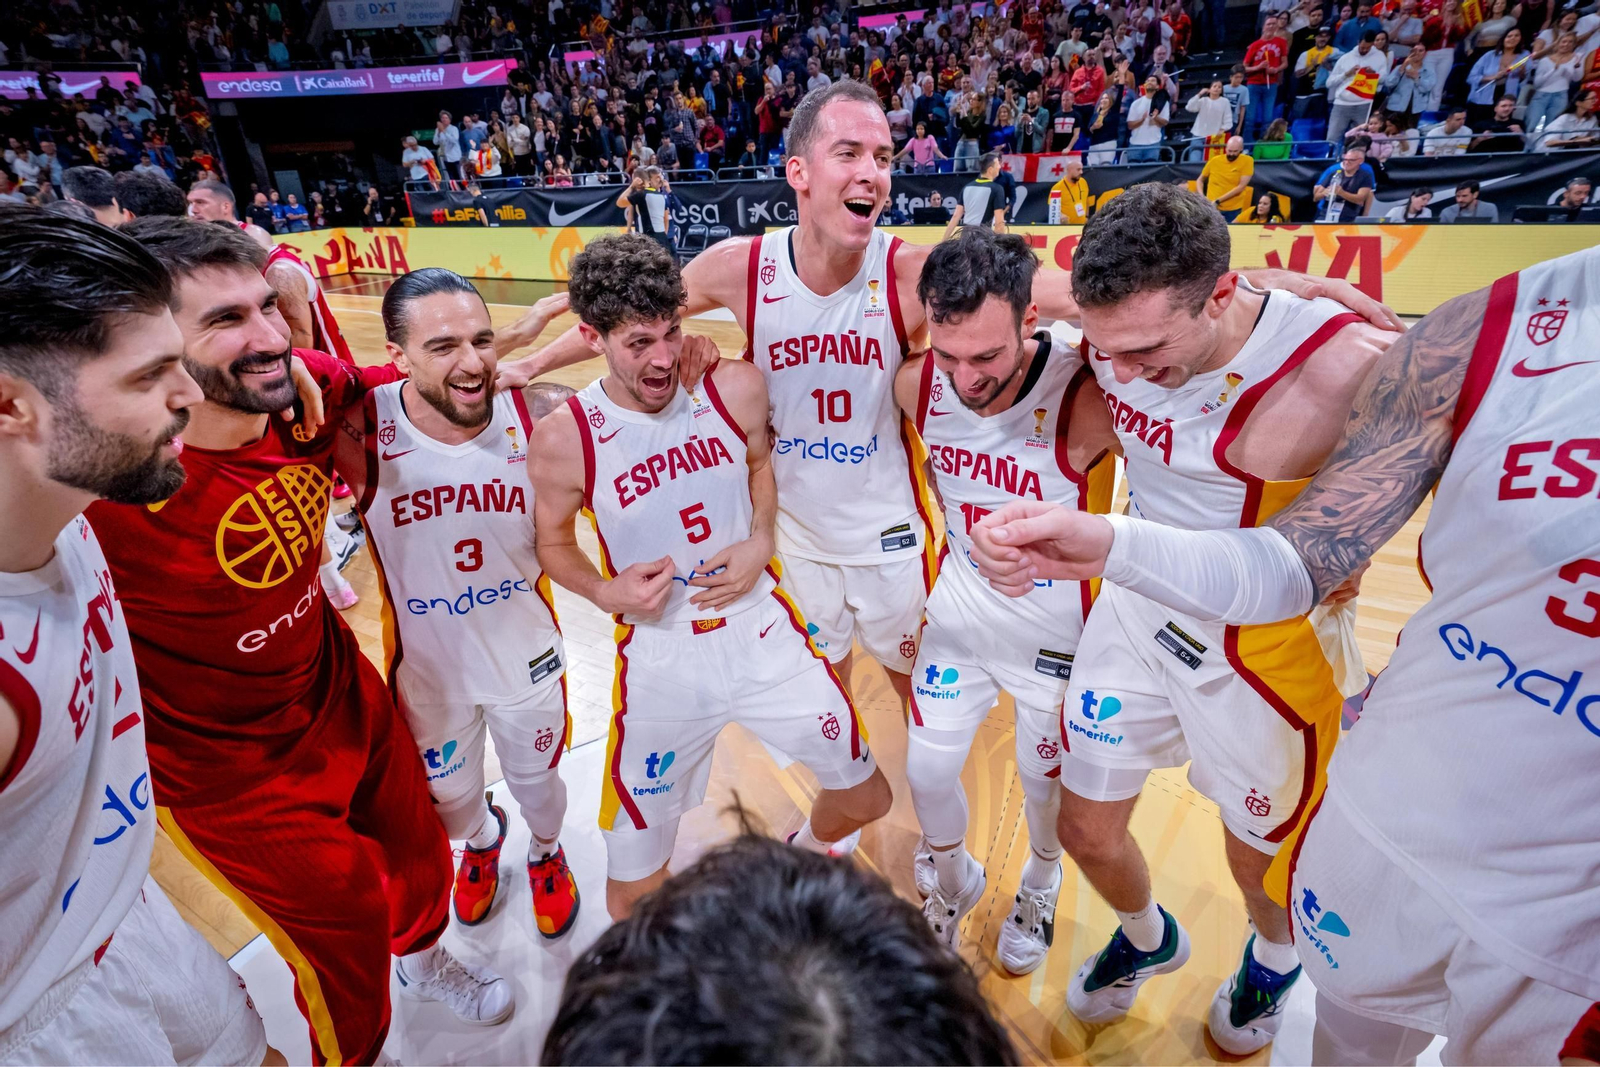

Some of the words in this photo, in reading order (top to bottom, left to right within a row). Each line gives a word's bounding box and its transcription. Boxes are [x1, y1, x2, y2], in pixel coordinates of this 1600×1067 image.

[368, 2, 397, 14] DXT
[218, 78, 282, 92] endesa
[318, 76, 368, 89] CaixaBank
[768, 329, 885, 372] ESPAÑA
[810, 388, 852, 425] 10
[613, 434, 735, 510] ESPAÑA
[929, 444, 1044, 501] ESPAÑA
[1498, 437, 1600, 502] ES
[390, 478, 527, 528] ESPAÑA
[678, 502, 712, 545] 5
[454, 537, 484, 573] 3
[1059, 667, 1070, 676] 48
[916, 685, 961, 701] tenerife!
[1069, 719, 1124, 747] tenerife!
[426, 756, 466, 782] enerife!
[632, 781, 675, 796] tenerife!
